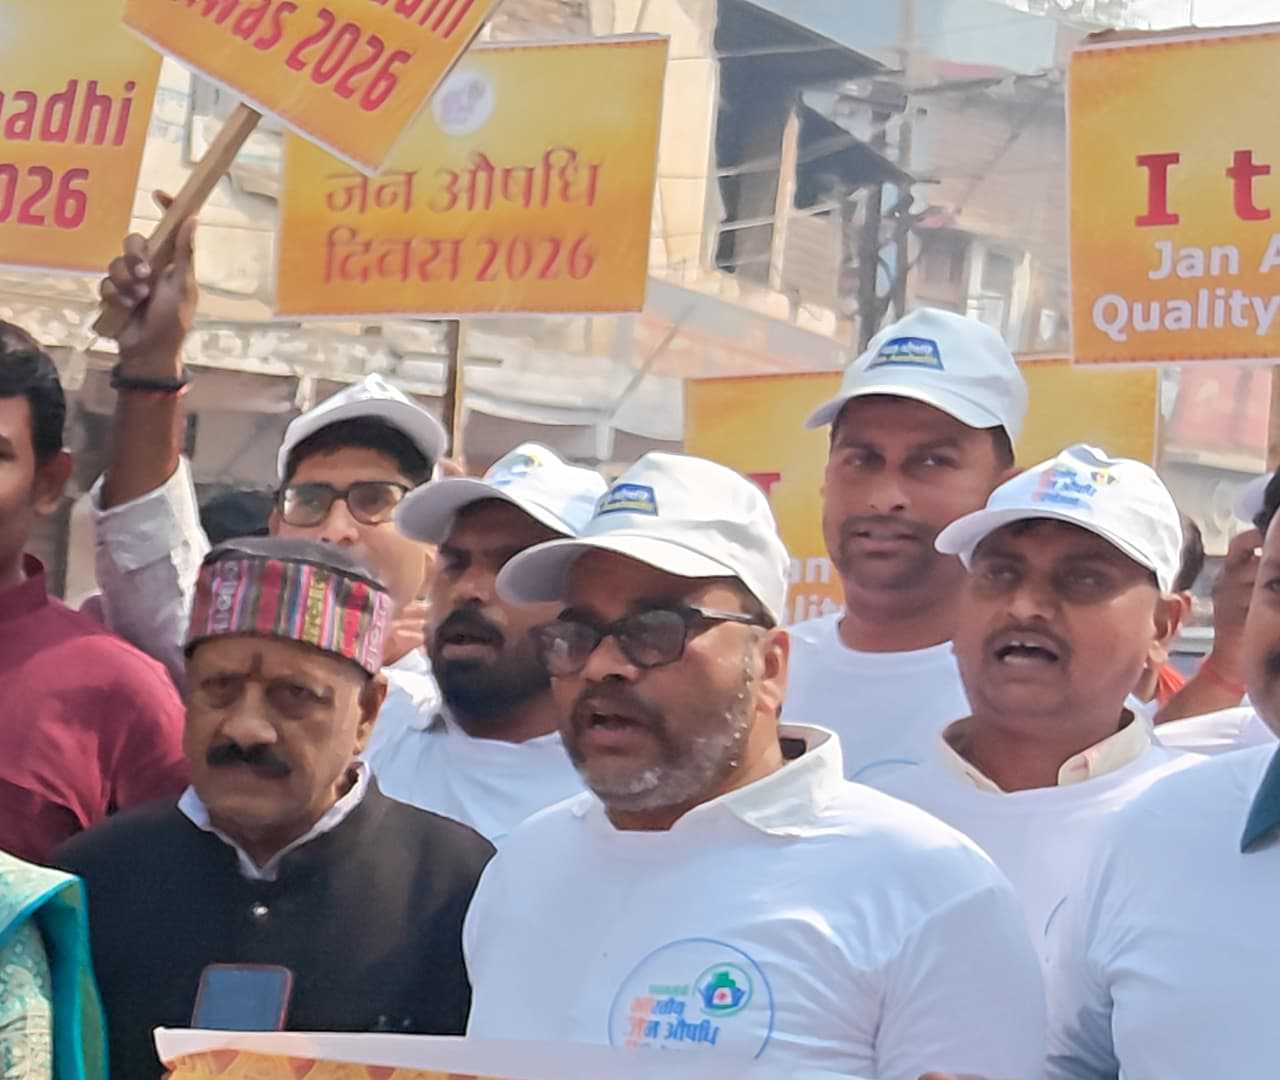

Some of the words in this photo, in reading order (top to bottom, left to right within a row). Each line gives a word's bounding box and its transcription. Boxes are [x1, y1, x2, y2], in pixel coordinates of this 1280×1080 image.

[285, 8, 411, 112] 2026
[324, 170, 417, 214] जन
[428, 147, 601, 211] औषधि
[1135, 153, 1180, 227] I
[324, 226, 463, 285] दिवस
[475, 235, 596, 282] 2026
[1148, 239, 1240, 280] Jan
[1092, 288, 1280, 342] Quality
